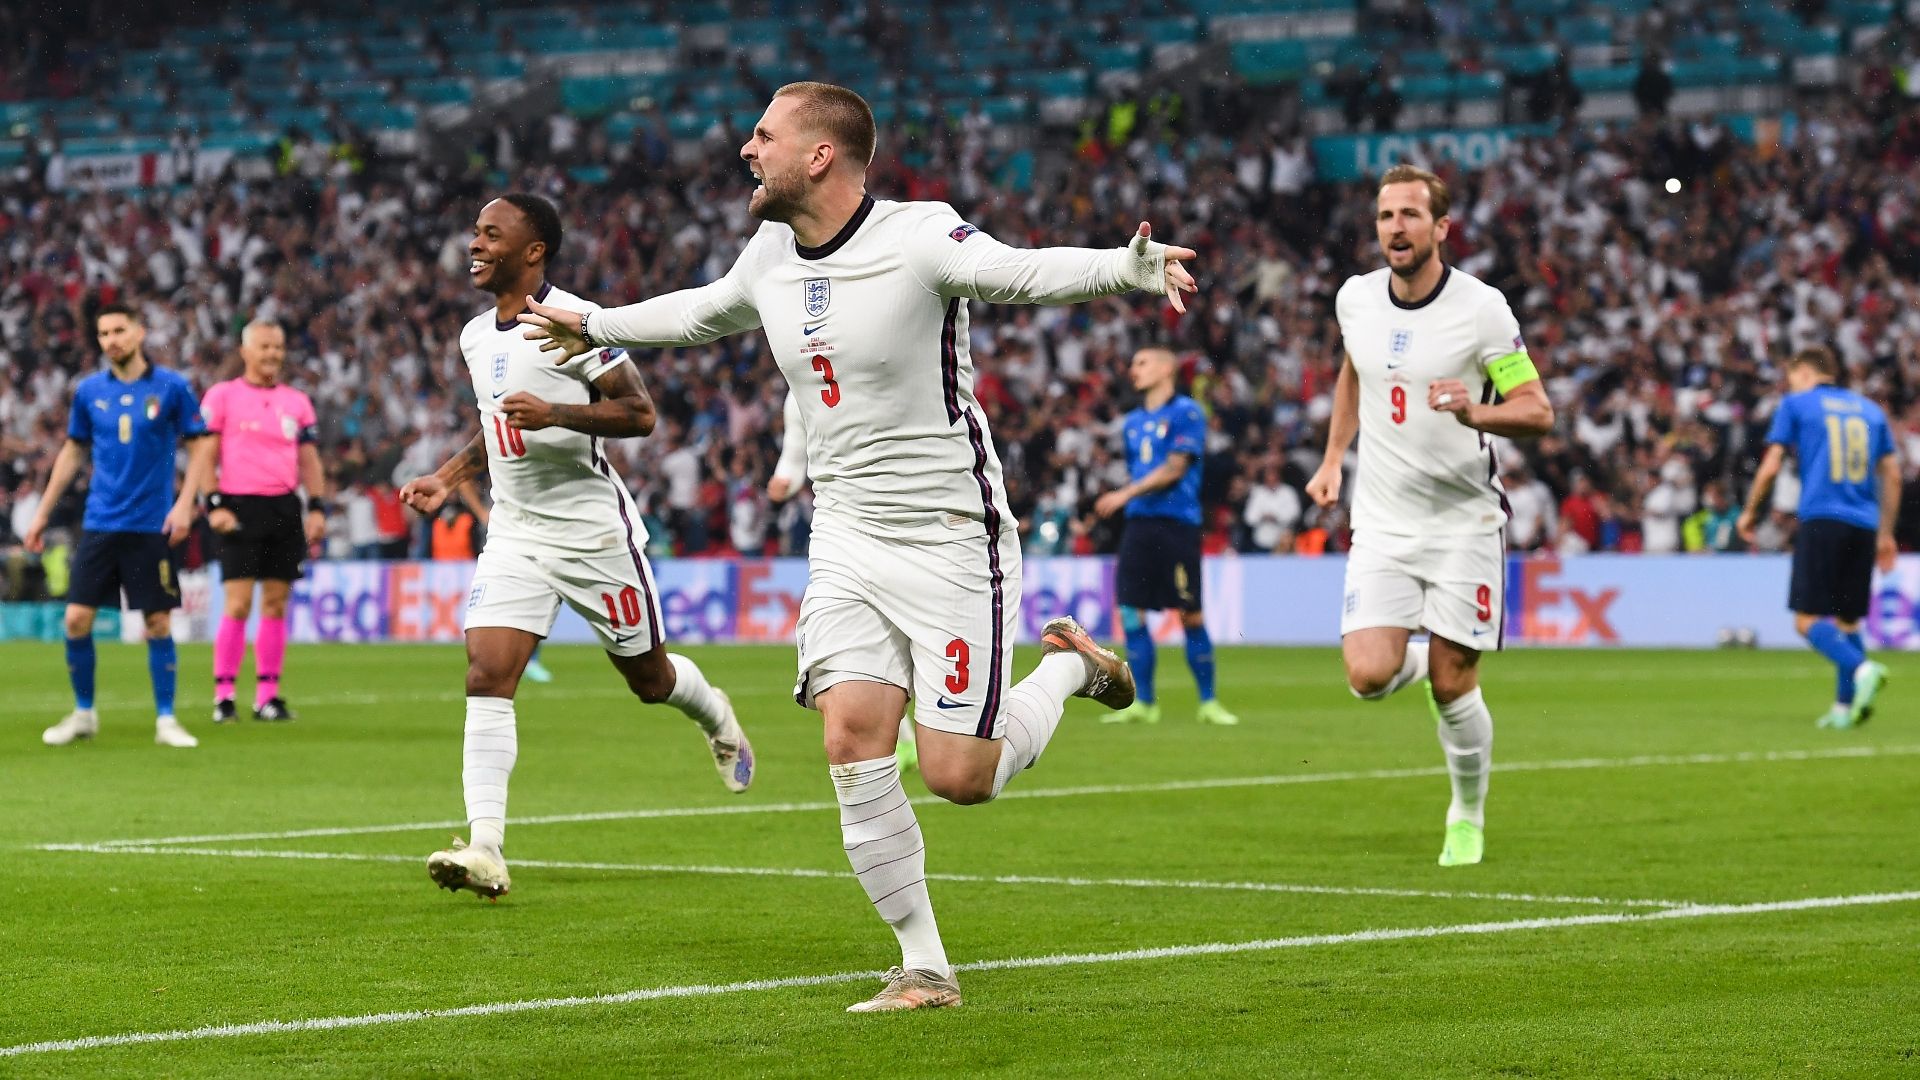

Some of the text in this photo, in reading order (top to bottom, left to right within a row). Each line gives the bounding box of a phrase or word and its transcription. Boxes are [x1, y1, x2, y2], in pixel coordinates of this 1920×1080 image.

[811, 354, 841, 408] 3
[1391, 386, 1406, 424] 9
[493, 415, 527, 457] 10
[1826, 414, 1869, 484] 18
[602, 585, 641, 629] 10
[1477, 585, 1491, 622] 9
[945, 638, 970, 695] 3
